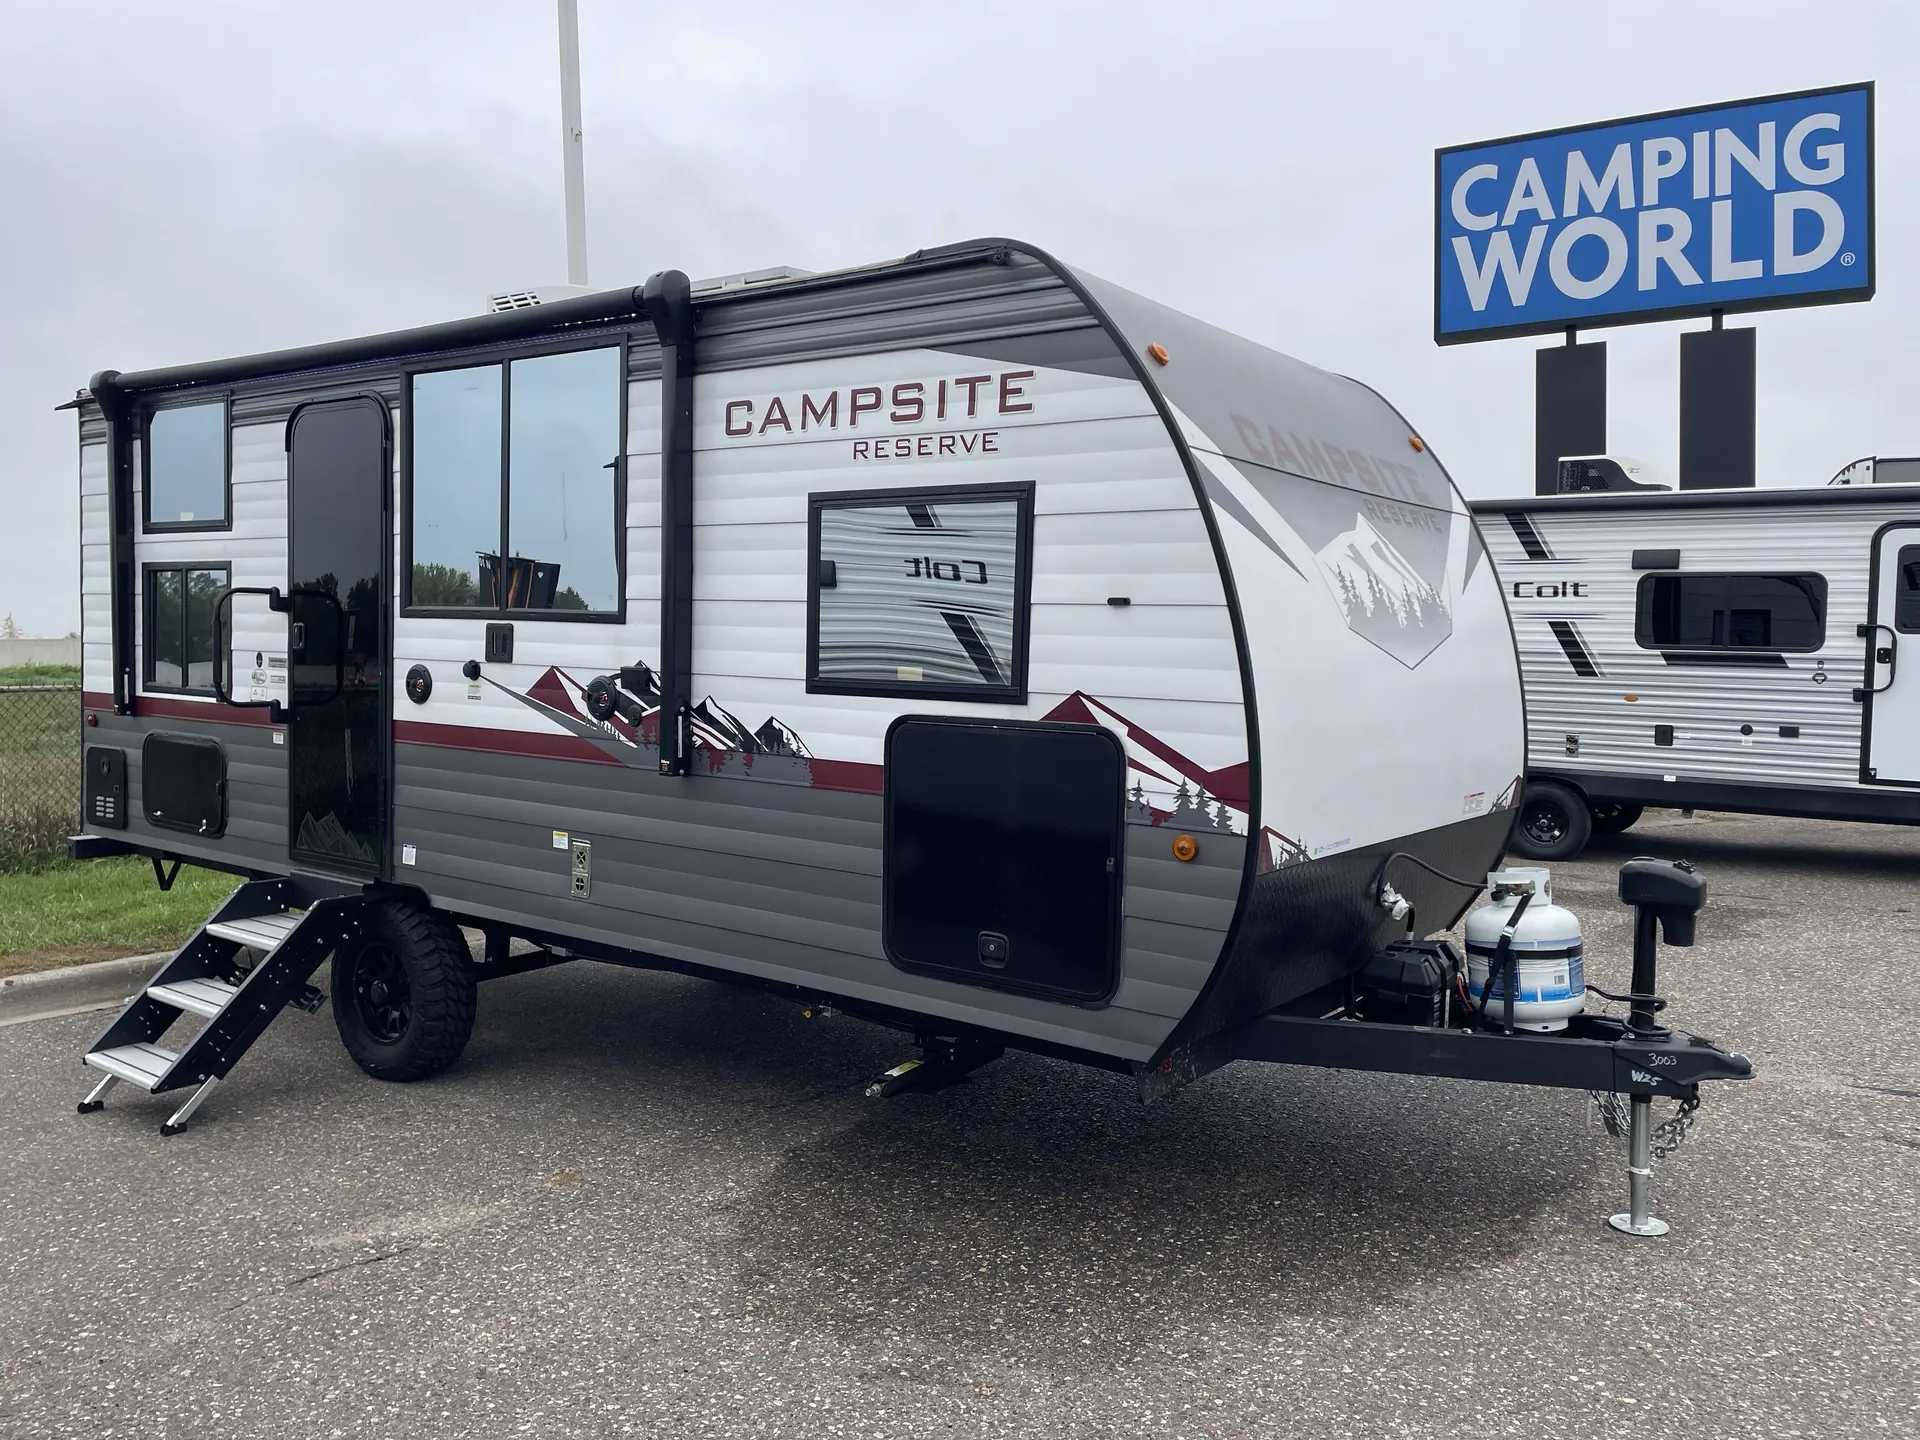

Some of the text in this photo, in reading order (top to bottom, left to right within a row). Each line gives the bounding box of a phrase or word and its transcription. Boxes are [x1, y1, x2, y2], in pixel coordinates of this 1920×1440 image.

[1451, 113, 1845, 231] CAMPING
[724, 370, 1036, 437] CAMPSITE
[853, 432, 1000, 460] RESERVE
[1229, 413, 1433, 505] CAMPSITE
[1363, 498, 1443, 533] RESERVE
[1513, 581, 1589, 598] Colt
[1648, 1053, 1677, 1067] 3003
